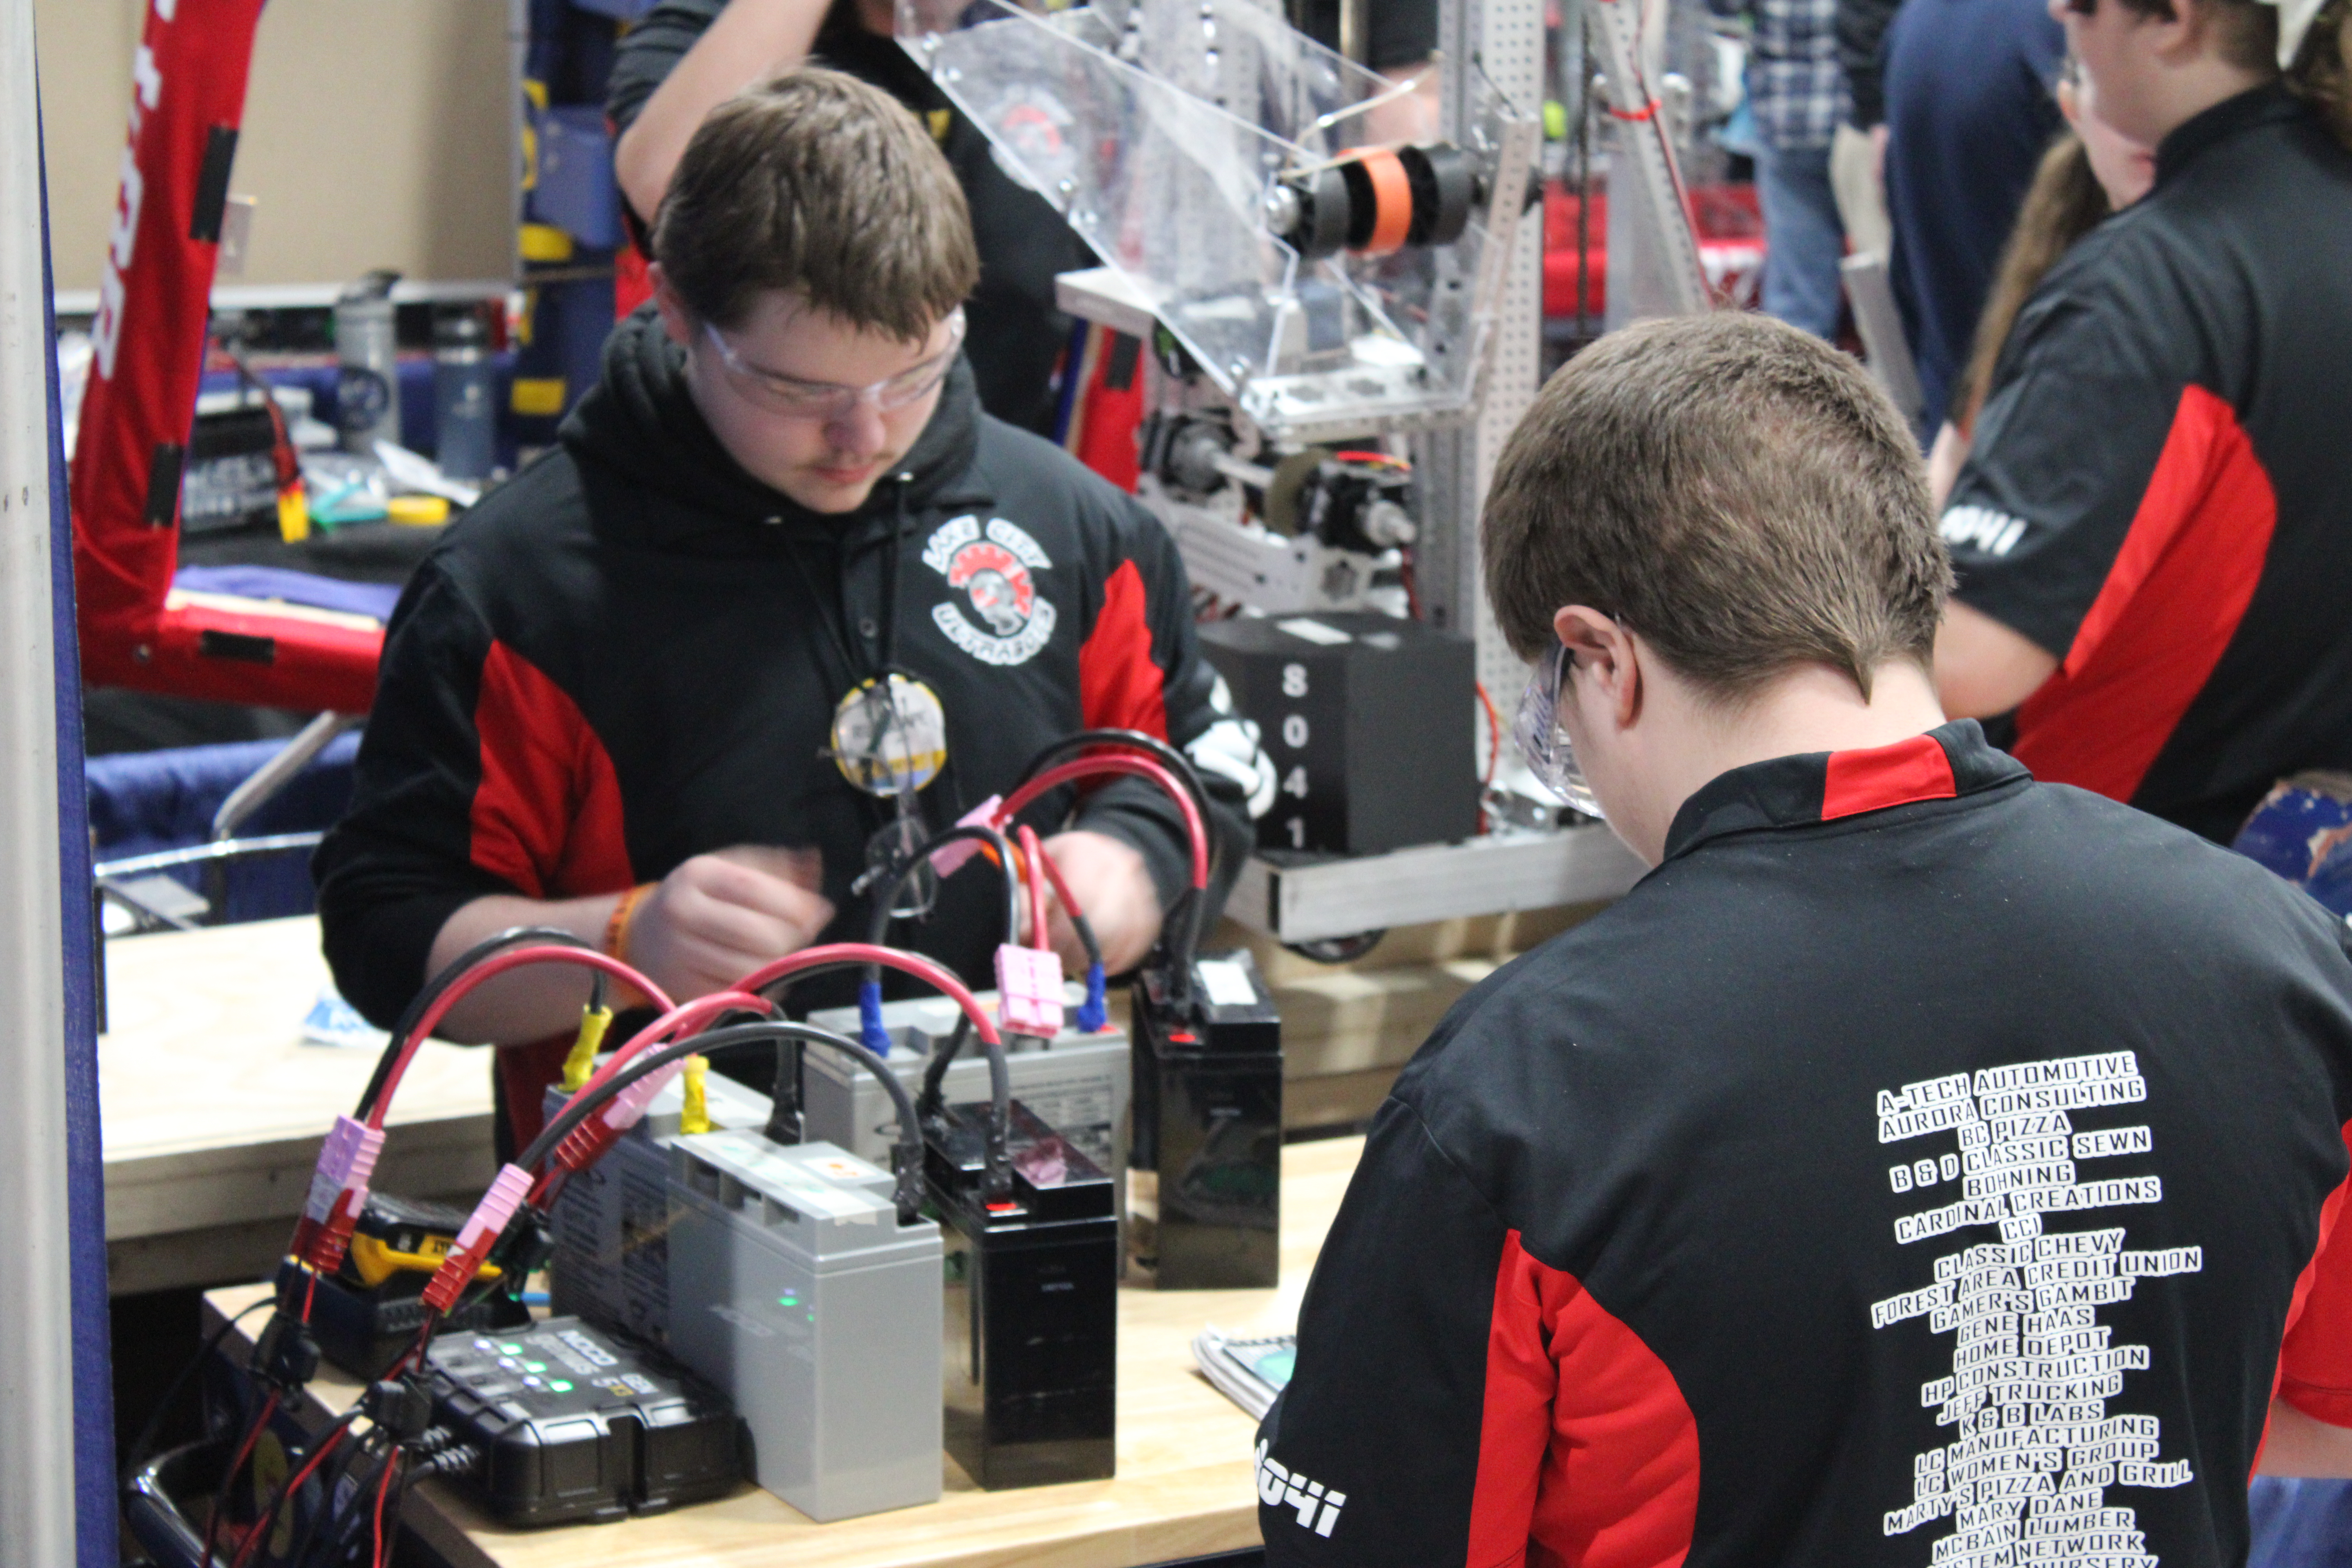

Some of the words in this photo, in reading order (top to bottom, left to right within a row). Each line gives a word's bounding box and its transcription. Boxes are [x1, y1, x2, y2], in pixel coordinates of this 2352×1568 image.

[1882, 1077, 1969, 1112] A-TECH
[1978, 1055, 2133, 1092] AUTOMOTIVE
[1883, 1103, 1975, 1139] AURORA
[1984, 1080, 2142, 1116] CONSULTING
[1962, 1125, 1986, 1147] BC
[1996, 1115, 2067, 1140] PIZZA
[1895, 1169, 1907, 1188] B
[1918, 1164, 1934, 1182] &
[1944, 1158, 1956, 1176] D
[1967, 1140, 2065, 1172] CLASSIC
[2077, 1130, 2148, 1154] SEWN
[1968, 1164, 2071, 1196] BOHNING
[1900, 1197, 2005, 1240] CARDINAL
[2016, 1181, 2157, 1212] CREATIONS
[2004, 1218, 2038, 1239] CCI
[1939, 1244, 2030, 1279] CLASSIC
[2039, 1232, 2121, 1256] CHEVY
[1876, 1286, 1952, 1324] FOREST
[1962, 1271, 2015, 1296] AREA
[2029, 1258, 2114, 1285] CREDIT
[2125, 1250, 2198, 1272] UNION
[1935, 1293, 2029, 1328] GAMER'S
[2041, 1280, 2131, 1306] GAMBIT
[1956, 1338, 2014, 1368] HOME
[2029, 1332, 2108, 1356] DEPOT
[1961, 1316, 2014, 1343] GENE
[2028, 1309, 2091, 1332] HAAS
[1926, 1381, 1952, 1403] HP
[1960, 1349, 2145, 1388] CONSTRUCTION
[1940, 1391, 1985, 1421] JEFF
[1993, 1376, 2119, 1401] TRUCKING
[1963, 1417, 1973, 1435] K
[1982, 1410, 1994, 1426] &
[2007, 1406, 2021, 1423] B
[2034, 1403, 2100, 1421] LABS
[1918, 1475, 1940, 1497] LC
[1951, 1452, 2057, 1485] WOMEN'S
[2071, 1444, 2155, 1466] GROUP
[1919, 1453, 1941, 1475] LC
[1952, 1419, 2155, 1460] MANUFACTURING
[1888, 1488, 1969, 1532] MARTY'S
[1982, 1476, 2051, 1499] PIZZA
[2064, 1467, 2111, 1487] AND
[2123, 1462, 2189, 1483] GRILL
[1961, 1501, 2022, 1528] MARY
[2033, 1492, 2099, 1514] DANE
[1936, 1548, 2010, 1568] STEM
[2021, 1534, 2143, 1561] NETWORK
[1937, 1524, 2016, 1561] MCBAIN
[2029, 1512, 2132, 1534] LUMBER
